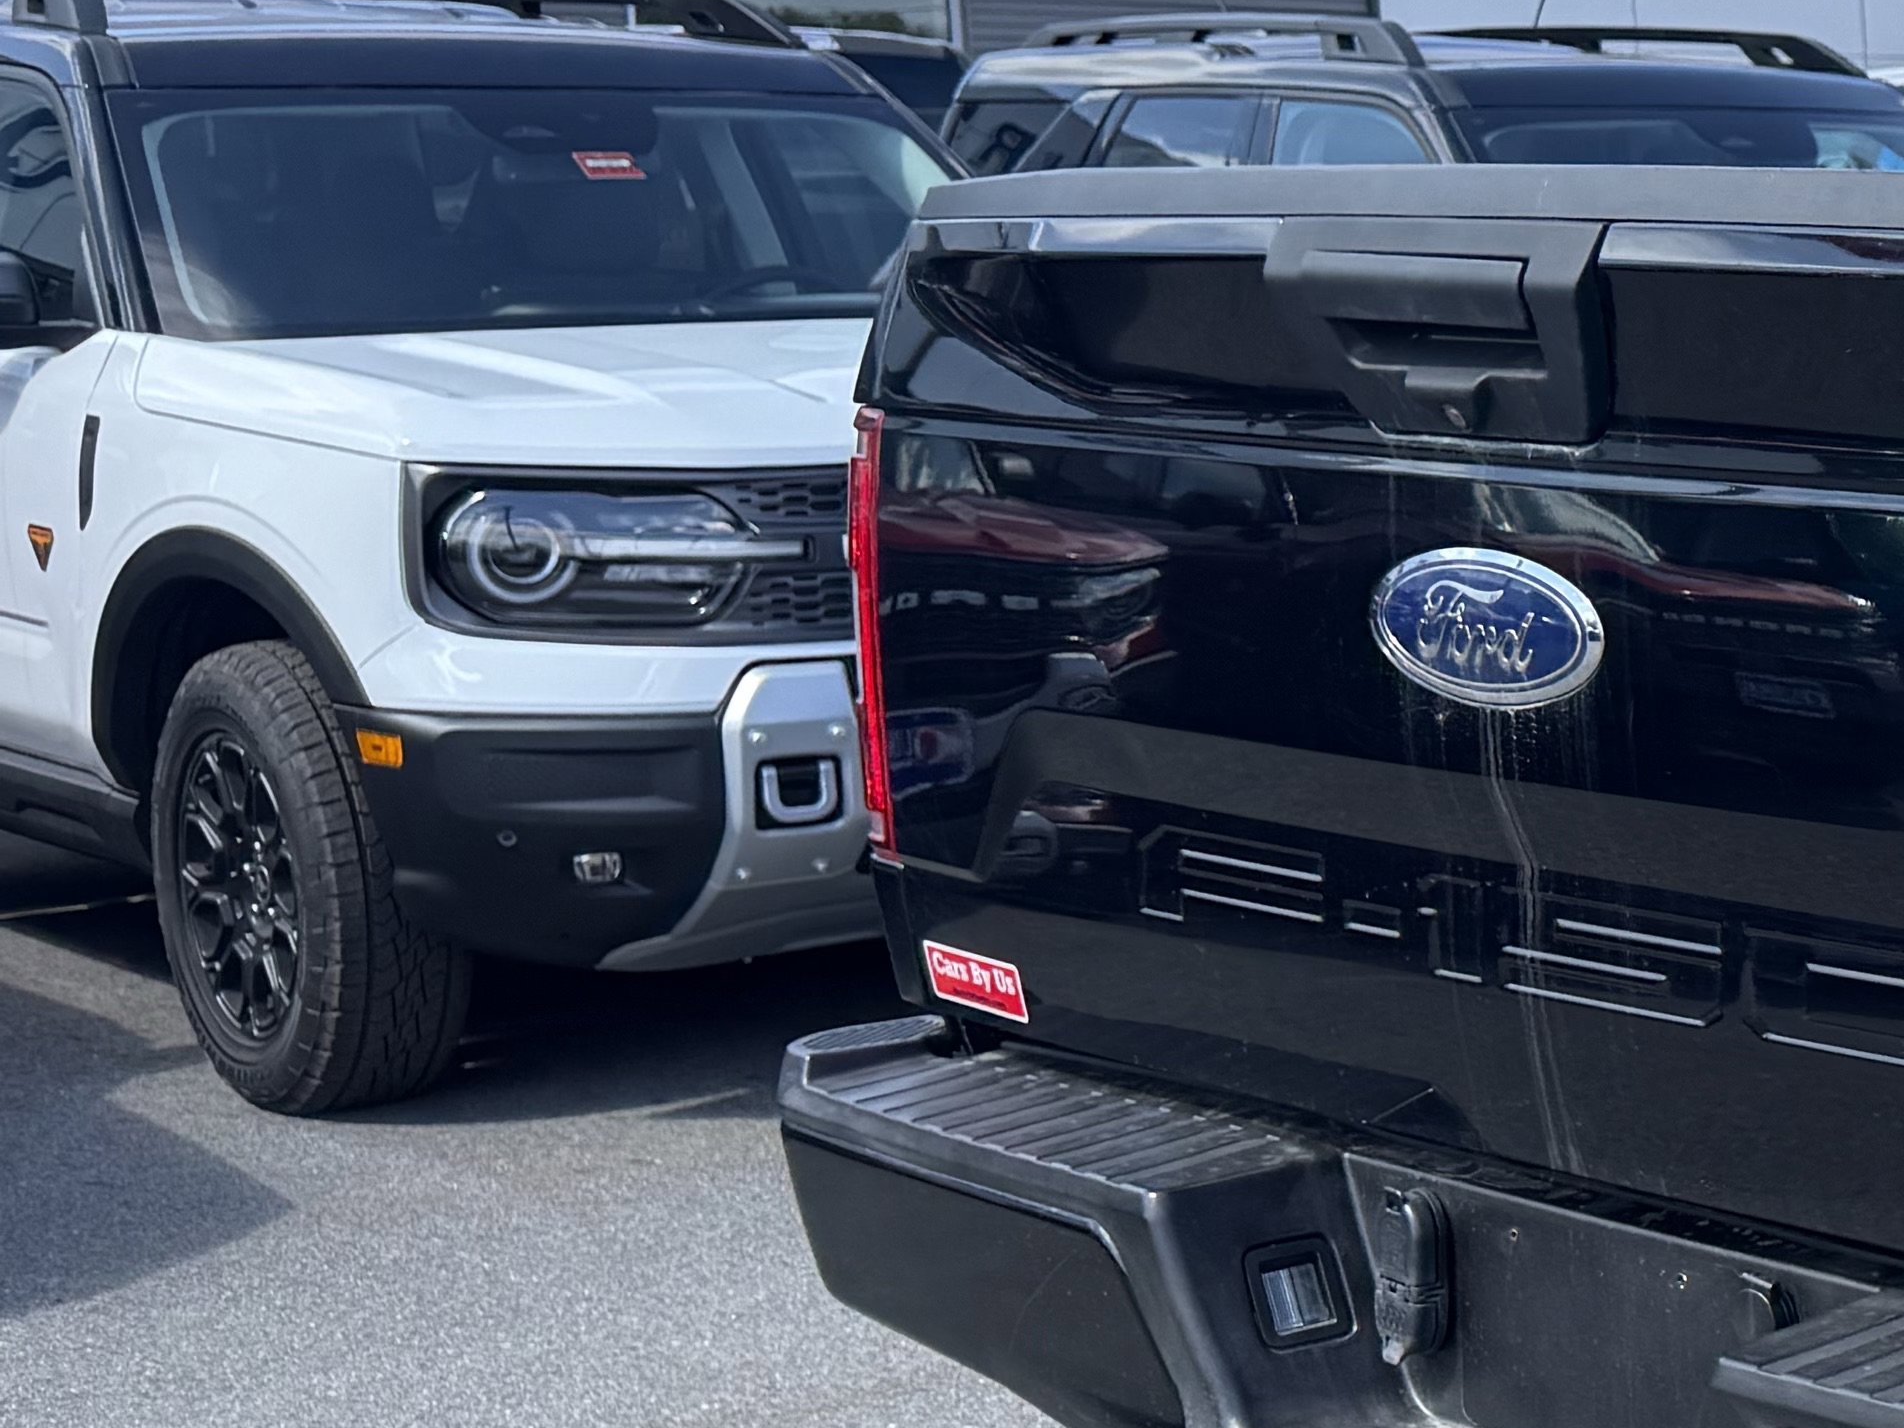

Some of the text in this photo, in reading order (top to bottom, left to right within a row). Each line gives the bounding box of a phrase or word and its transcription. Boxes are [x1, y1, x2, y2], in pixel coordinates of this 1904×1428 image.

[1416, 579, 1534, 674] Ford
[932, 950, 1016, 996] Cars By Us
